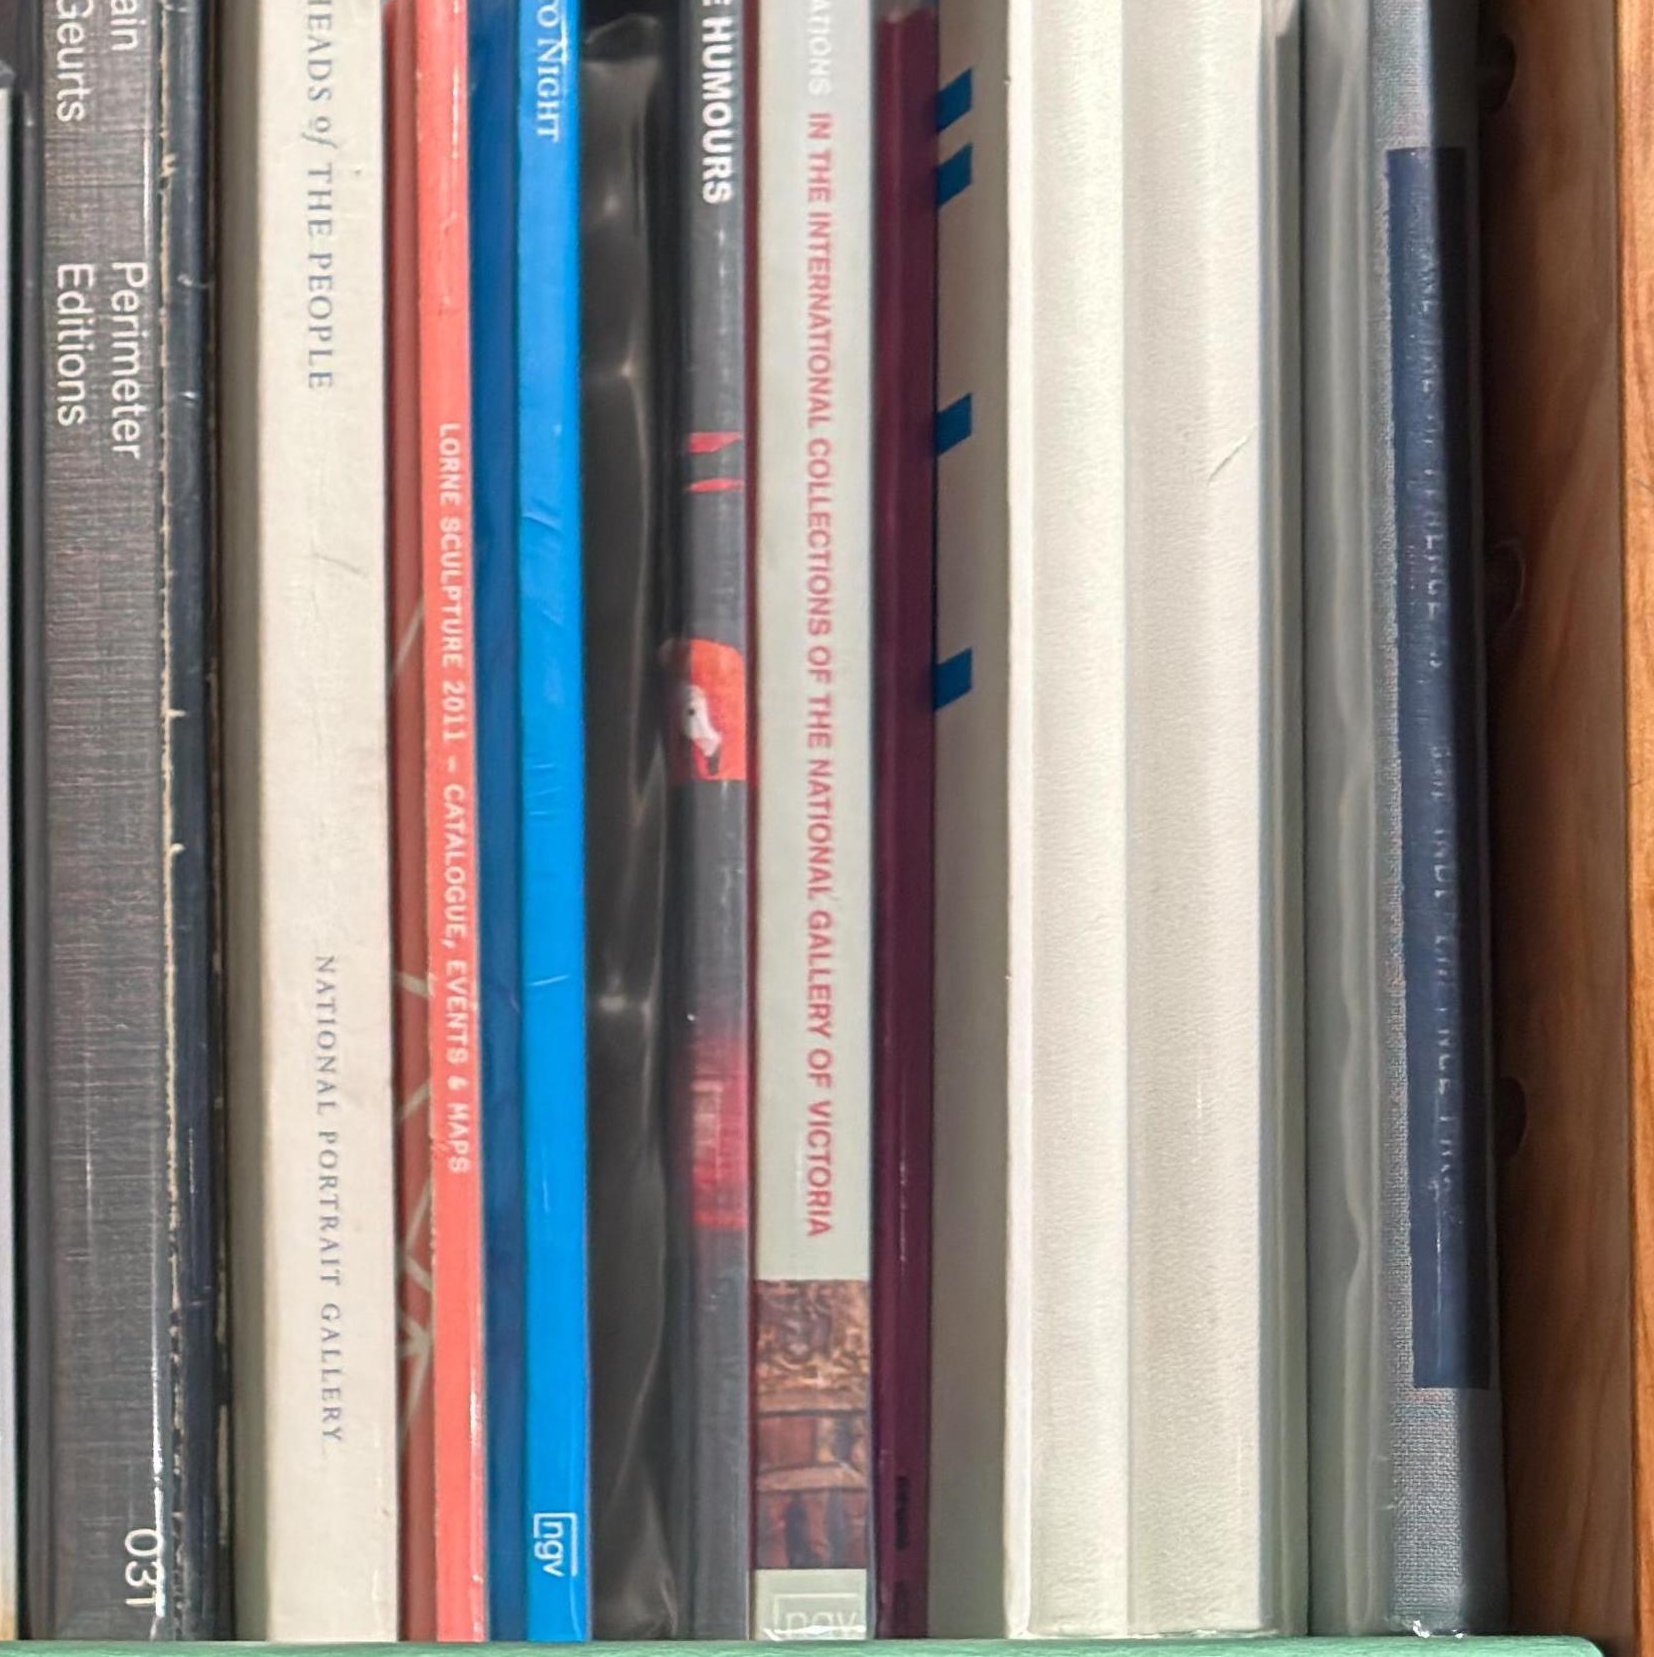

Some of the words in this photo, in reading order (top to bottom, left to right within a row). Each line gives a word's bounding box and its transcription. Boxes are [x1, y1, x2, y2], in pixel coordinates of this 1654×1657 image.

[698, 17, 734, 204] HUMOURS
[806, 148, 832, 201] THE
[308, 162, 335, 237] THE
[56, 262, 95, 426] Editions
[108, 260, 147, 459] Perimeter
[309, 250, 335, 390] PEOPLE
[806, 212, 832, 429] INTERNATIONAL
[439, 423, 462, 506] LORNE
[440, 516, 464, 667] SCULPTURE
[806, 439, 832, 635] COLLECTIONS
[806, 693, 832, 749] THE
[806, 759, 832, 898] NATIONAL
[316, 956, 336, 1119] NATIONAL
[447, 960, 469, 1065] EVENTS
[806, 910, 832, 1038] GALLERY
[448, 1102, 471, 1174] MAPS
[806, 1099, 832, 1236] VICTORIA
[317, 1130, 339, 1288] PORTRAIT
[321, 1303, 342, 1444] GALLERY
